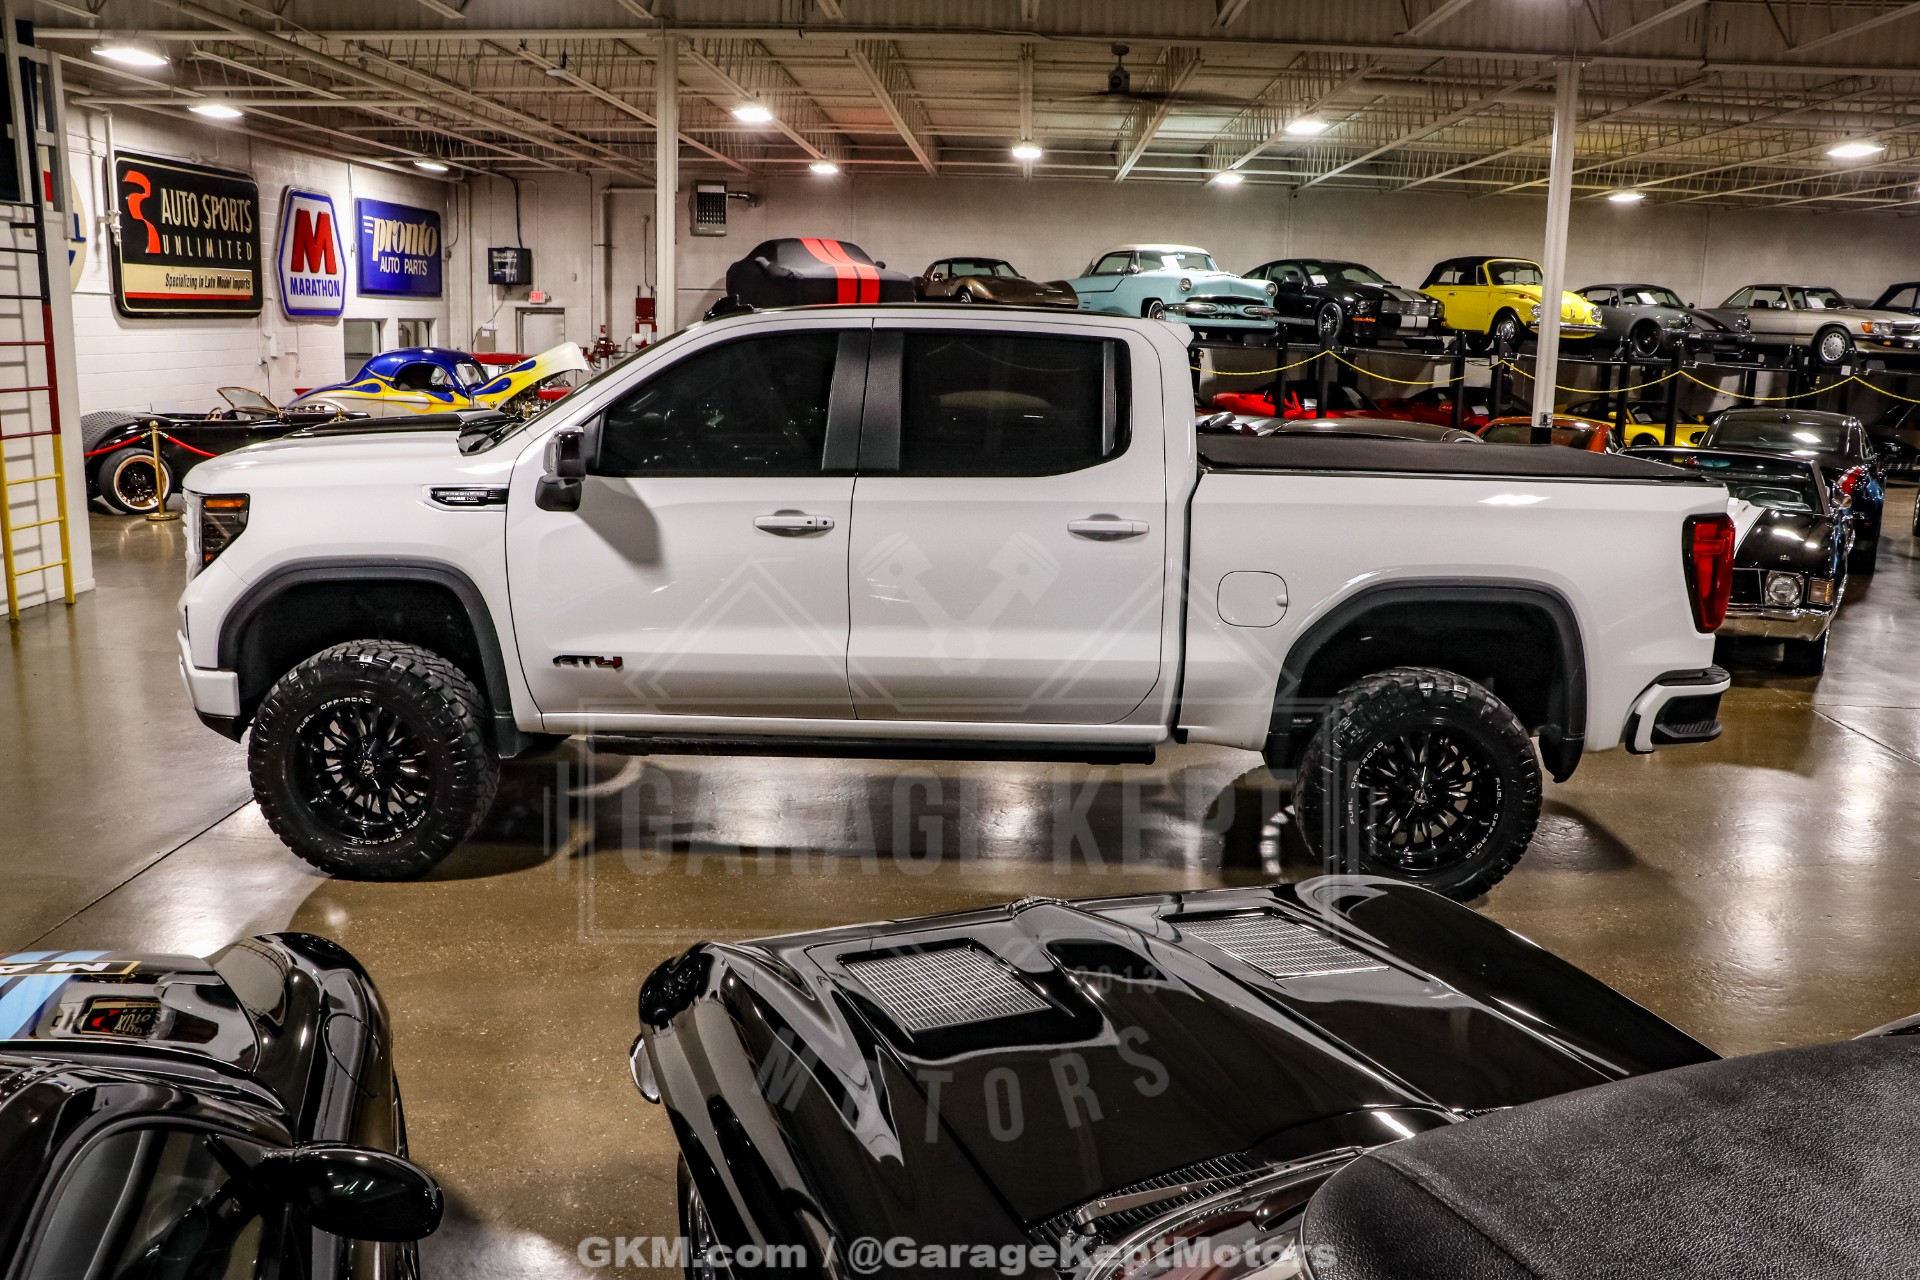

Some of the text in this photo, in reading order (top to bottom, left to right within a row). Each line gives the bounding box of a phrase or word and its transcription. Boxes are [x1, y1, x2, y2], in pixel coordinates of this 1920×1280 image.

[160, 188, 253, 234] AUTO SPORTS
[162, 234, 253, 261] UNLIMITED
[291, 208, 337, 275] M
[372, 217, 438, 262] pronto
[165, 272, 198, 290] Specializing
[205, 275, 216, 288] Late
[217, 275, 232, 289] Model
[379, 256, 428, 276] AUTO PARTS
[290, 276, 340, 298] MARATHON
[531, 291, 543, 301] EXIT
[296, 697, 372, 734] FUEL OFF-ROAD
[1347, 741, 1384, 825] FUEL OFF-ROAD
[1466, 813, 1499, 859] OFF-ROAD
